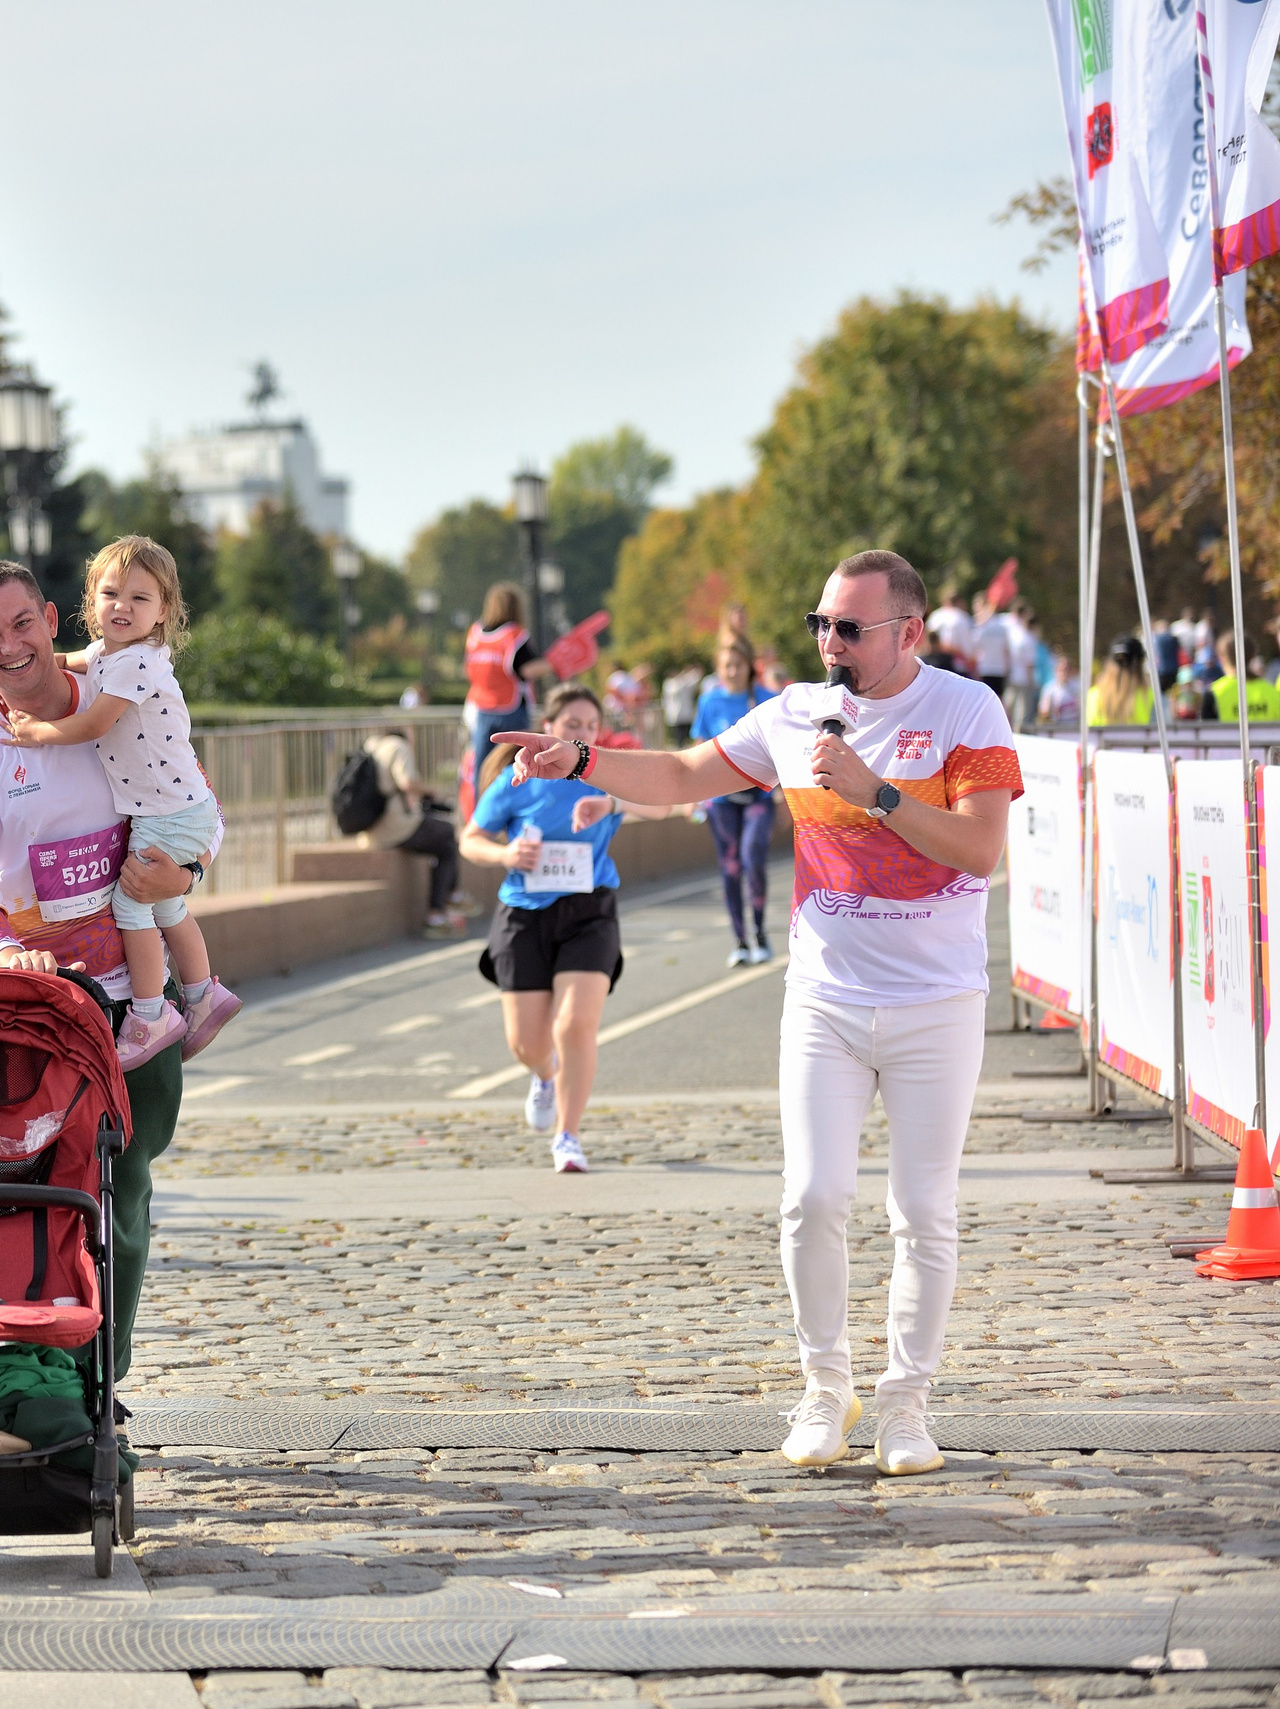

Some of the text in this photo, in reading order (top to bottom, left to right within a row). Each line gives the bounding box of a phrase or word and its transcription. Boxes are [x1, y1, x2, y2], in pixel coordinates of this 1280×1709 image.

[62, 857, 111, 886] 5220
[542, 864, 576, 877] 8016
[882, 912, 902, 920] TO
[905, 911, 932, 920] RUN
